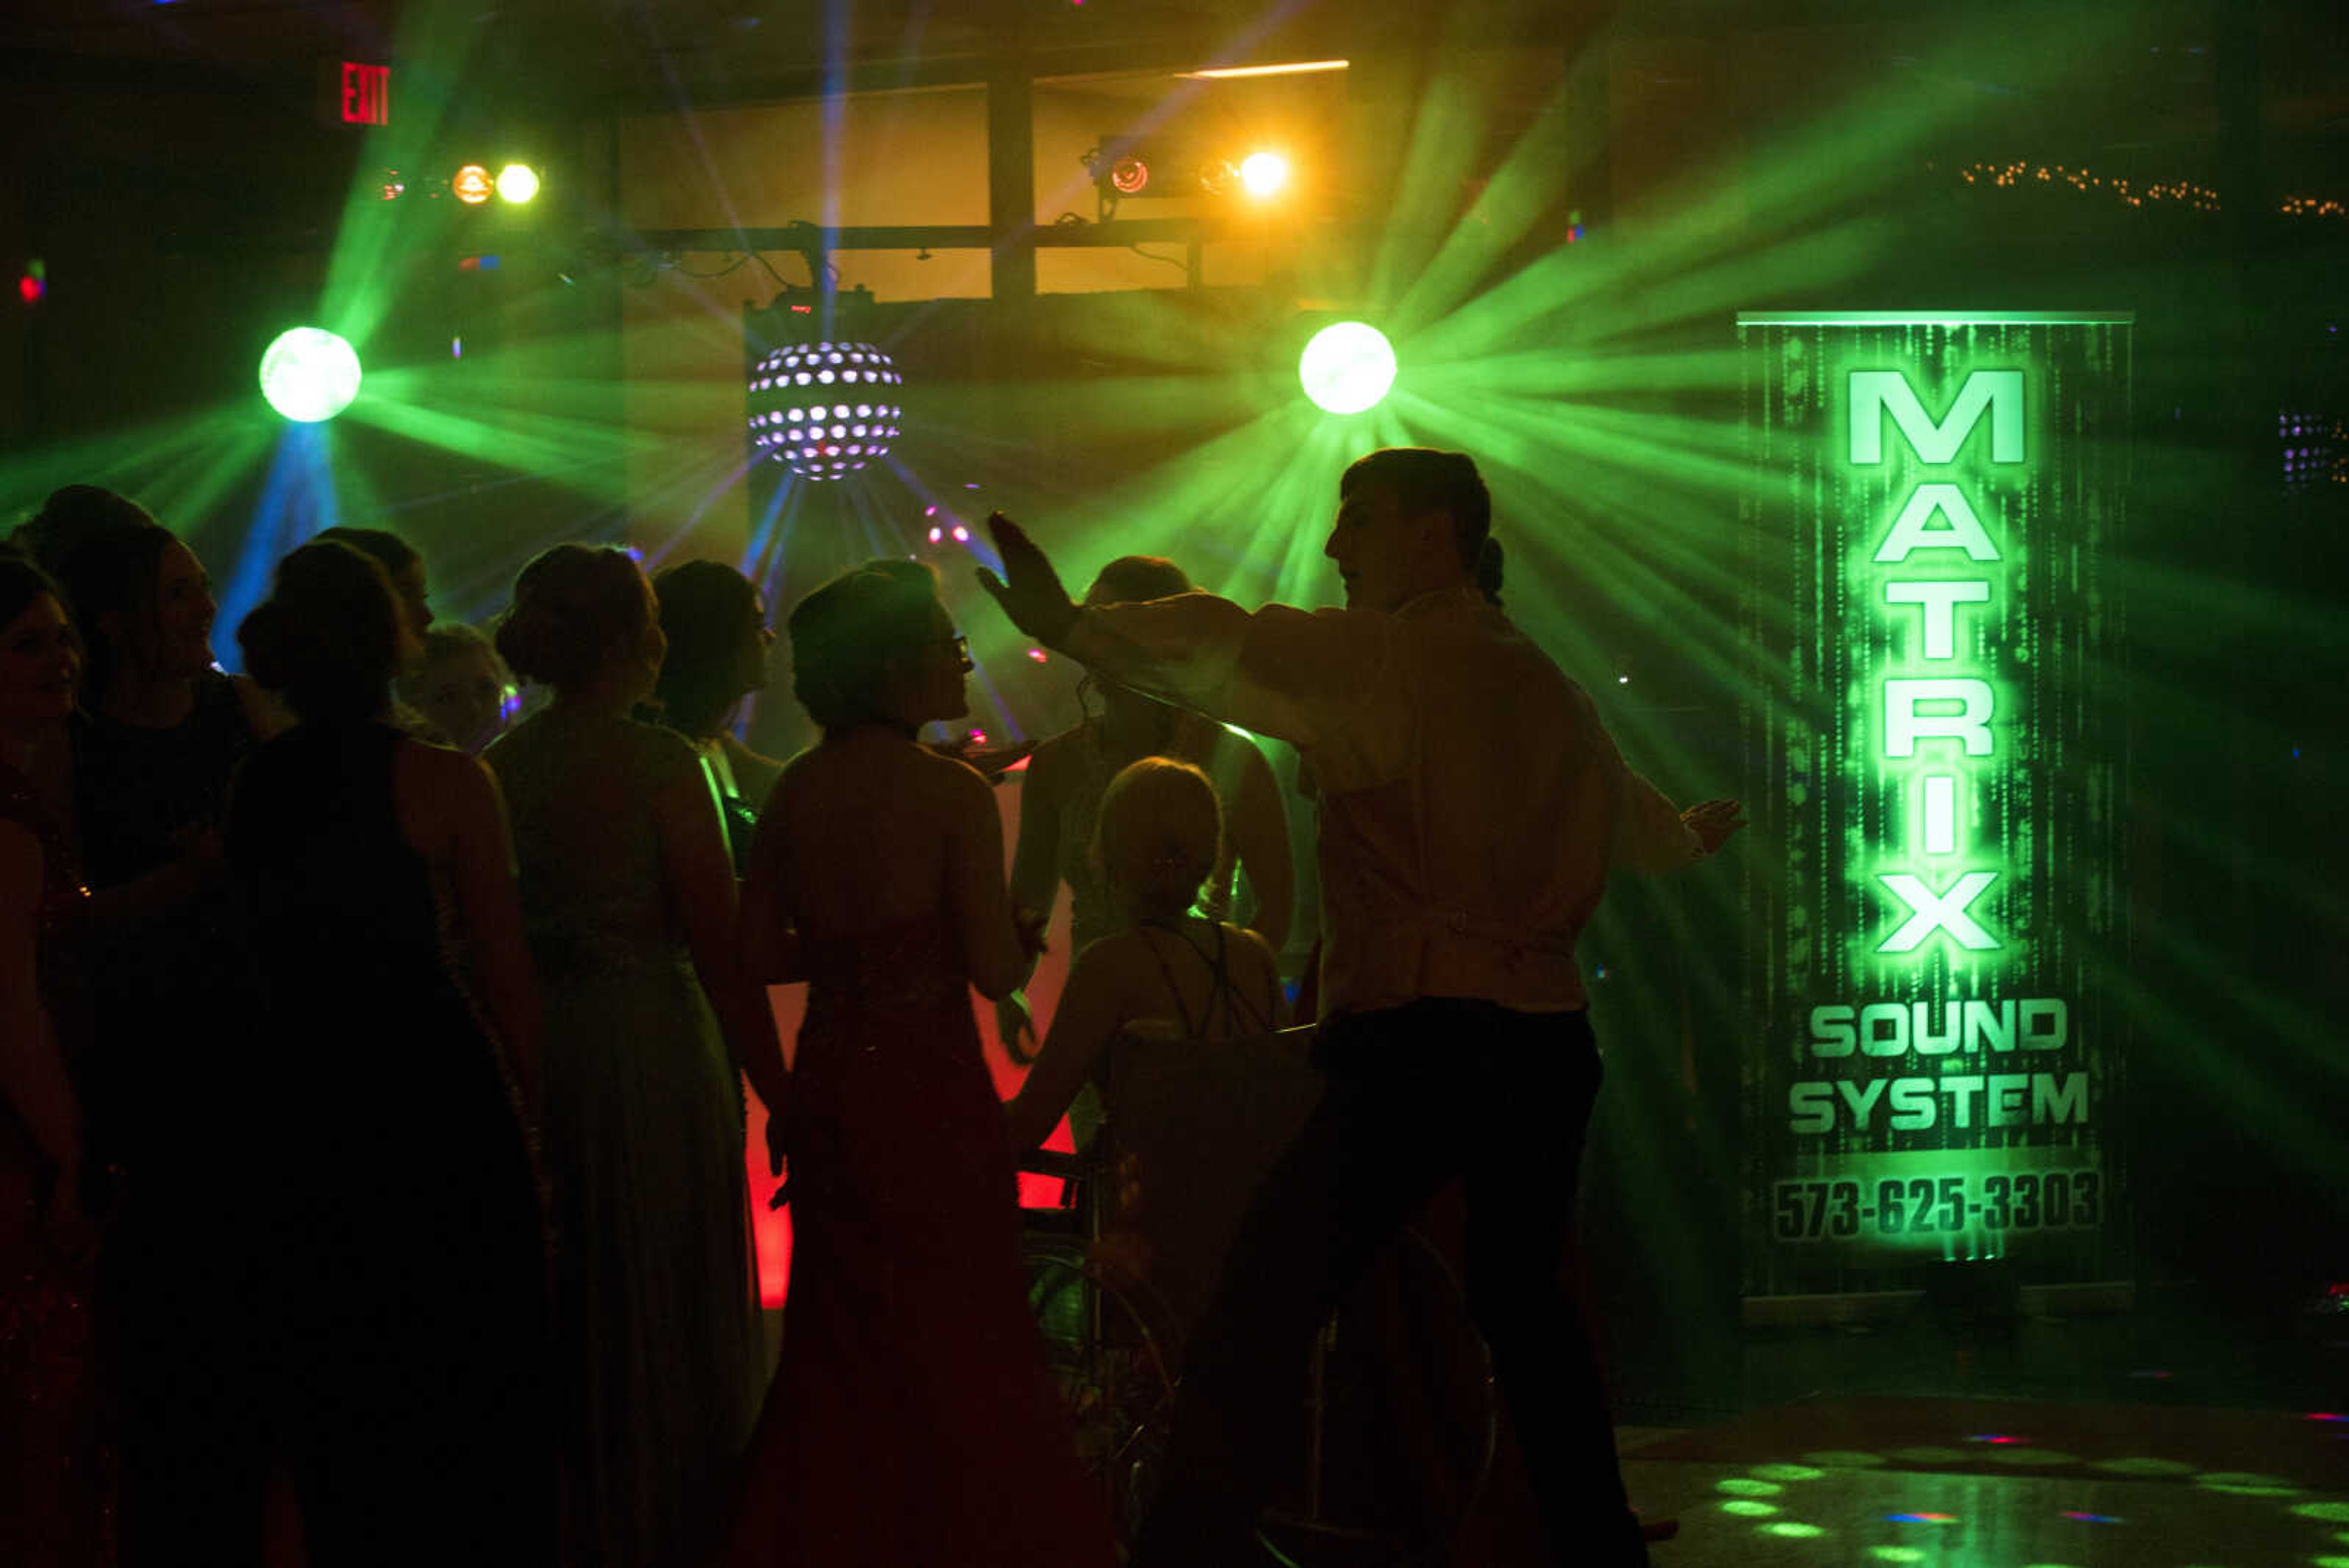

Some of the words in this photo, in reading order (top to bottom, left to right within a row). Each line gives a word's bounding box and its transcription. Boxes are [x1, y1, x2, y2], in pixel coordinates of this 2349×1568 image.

[1848, 370, 2025, 953] MATRIX
[1809, 998, 2068, 1058] SOUND
[1788, 1072, 2089, 1134] SYSTEM
[1775, 1171, 2101, 1240] 573-625-3303
